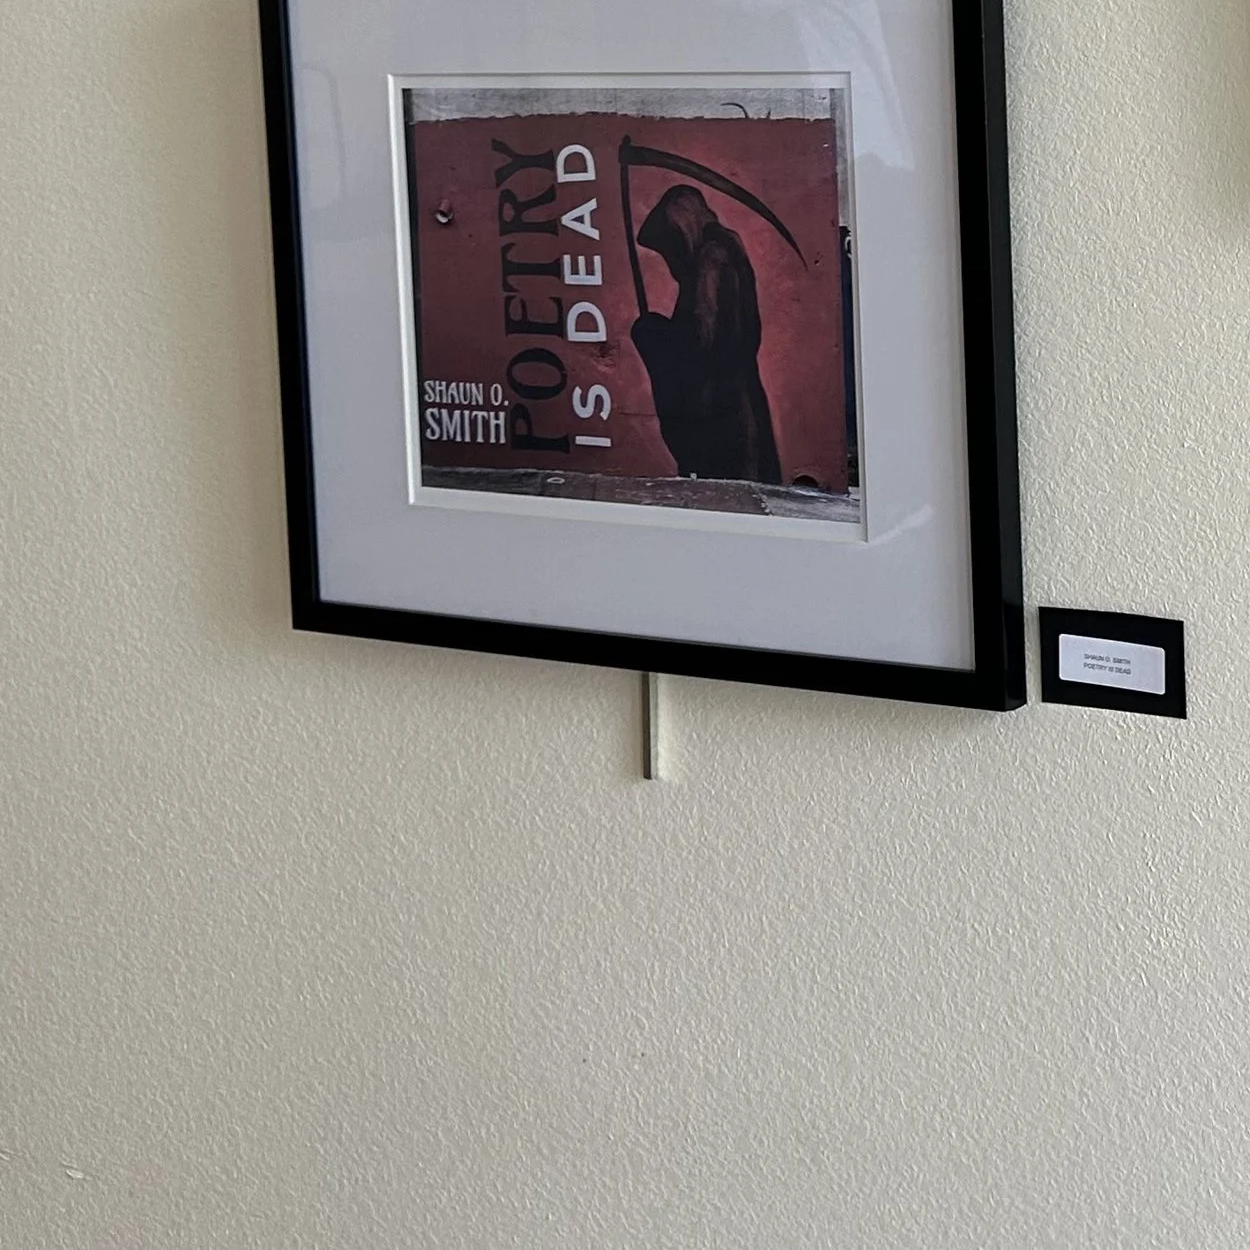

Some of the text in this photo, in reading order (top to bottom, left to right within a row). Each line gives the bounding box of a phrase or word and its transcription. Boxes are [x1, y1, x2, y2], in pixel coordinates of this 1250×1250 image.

[491, 137, 571, 454] POETRY
[555, 143, 612, 448] IS DEAD
[423, 380, 509, 406] SHAUN O.
[424, 407, 506, 444] SMITH
[1083, 653, 1104, 661] SHAUN
[1112, 657, 1131, 665] SMITH
[1083, 662, 1107, 671] POETRY
[1114, 666, 1132, 675] DEAD
